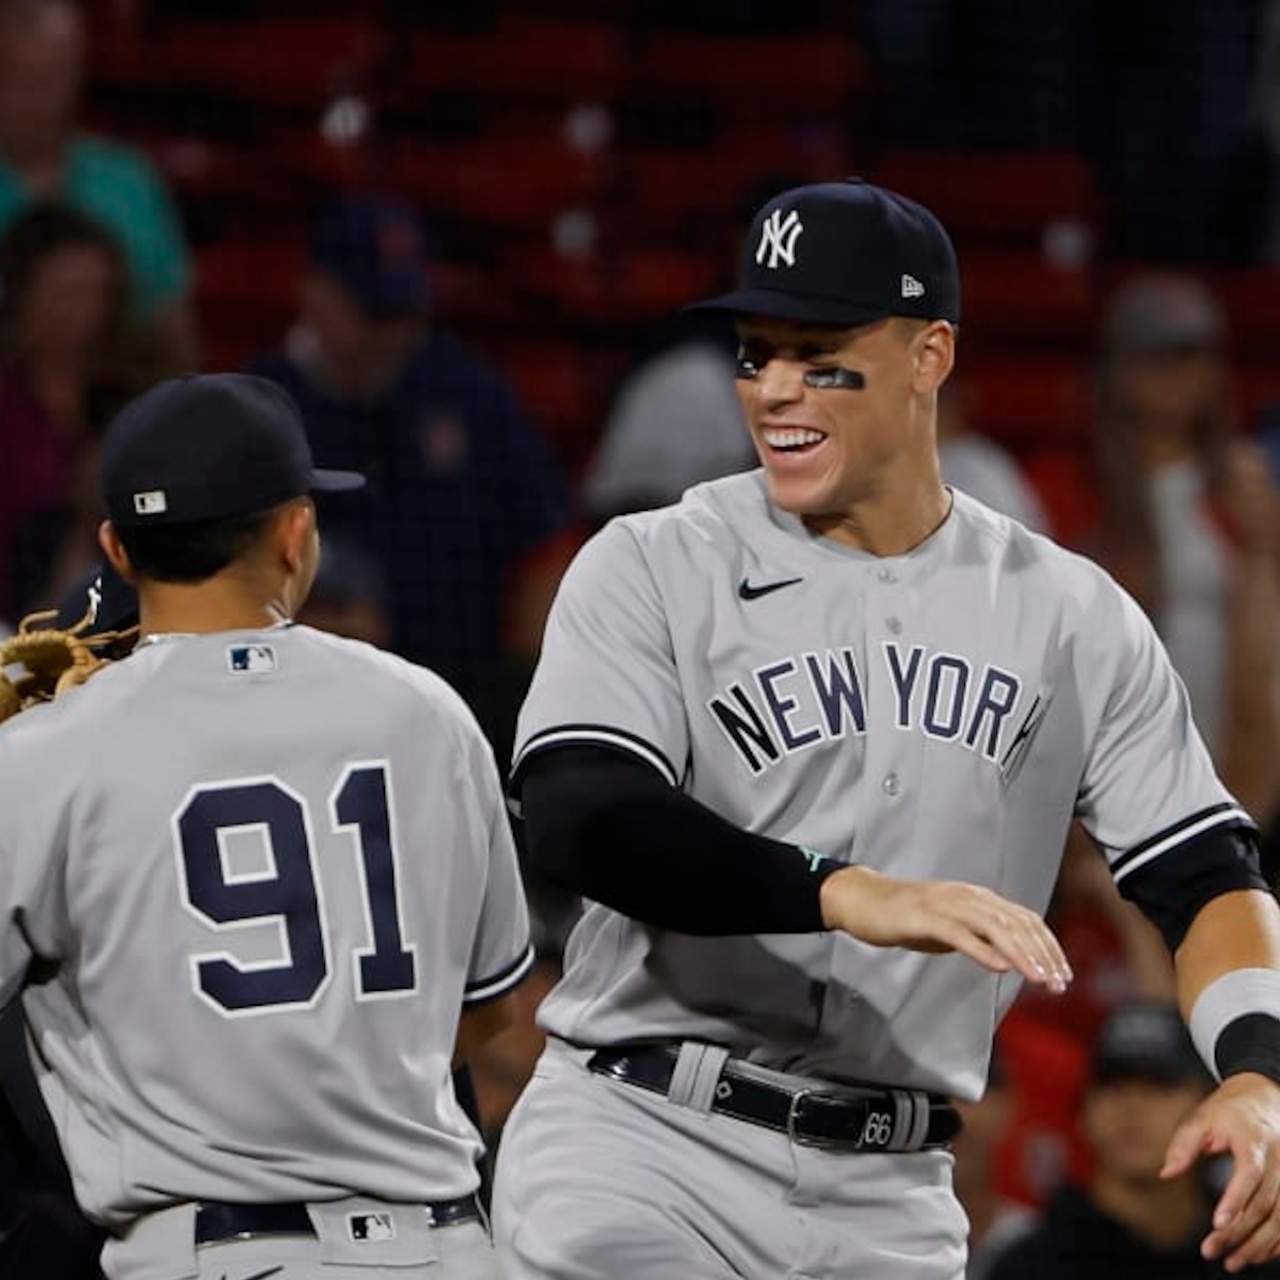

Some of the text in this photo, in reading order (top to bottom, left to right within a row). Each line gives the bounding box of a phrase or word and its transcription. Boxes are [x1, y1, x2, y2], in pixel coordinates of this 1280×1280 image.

[756, 209, 803, 268] NY
[705, 648, 868, 776] NEW
[171, 758, 419, 1019] 91
[866, 1111, 892, 1145] 66
